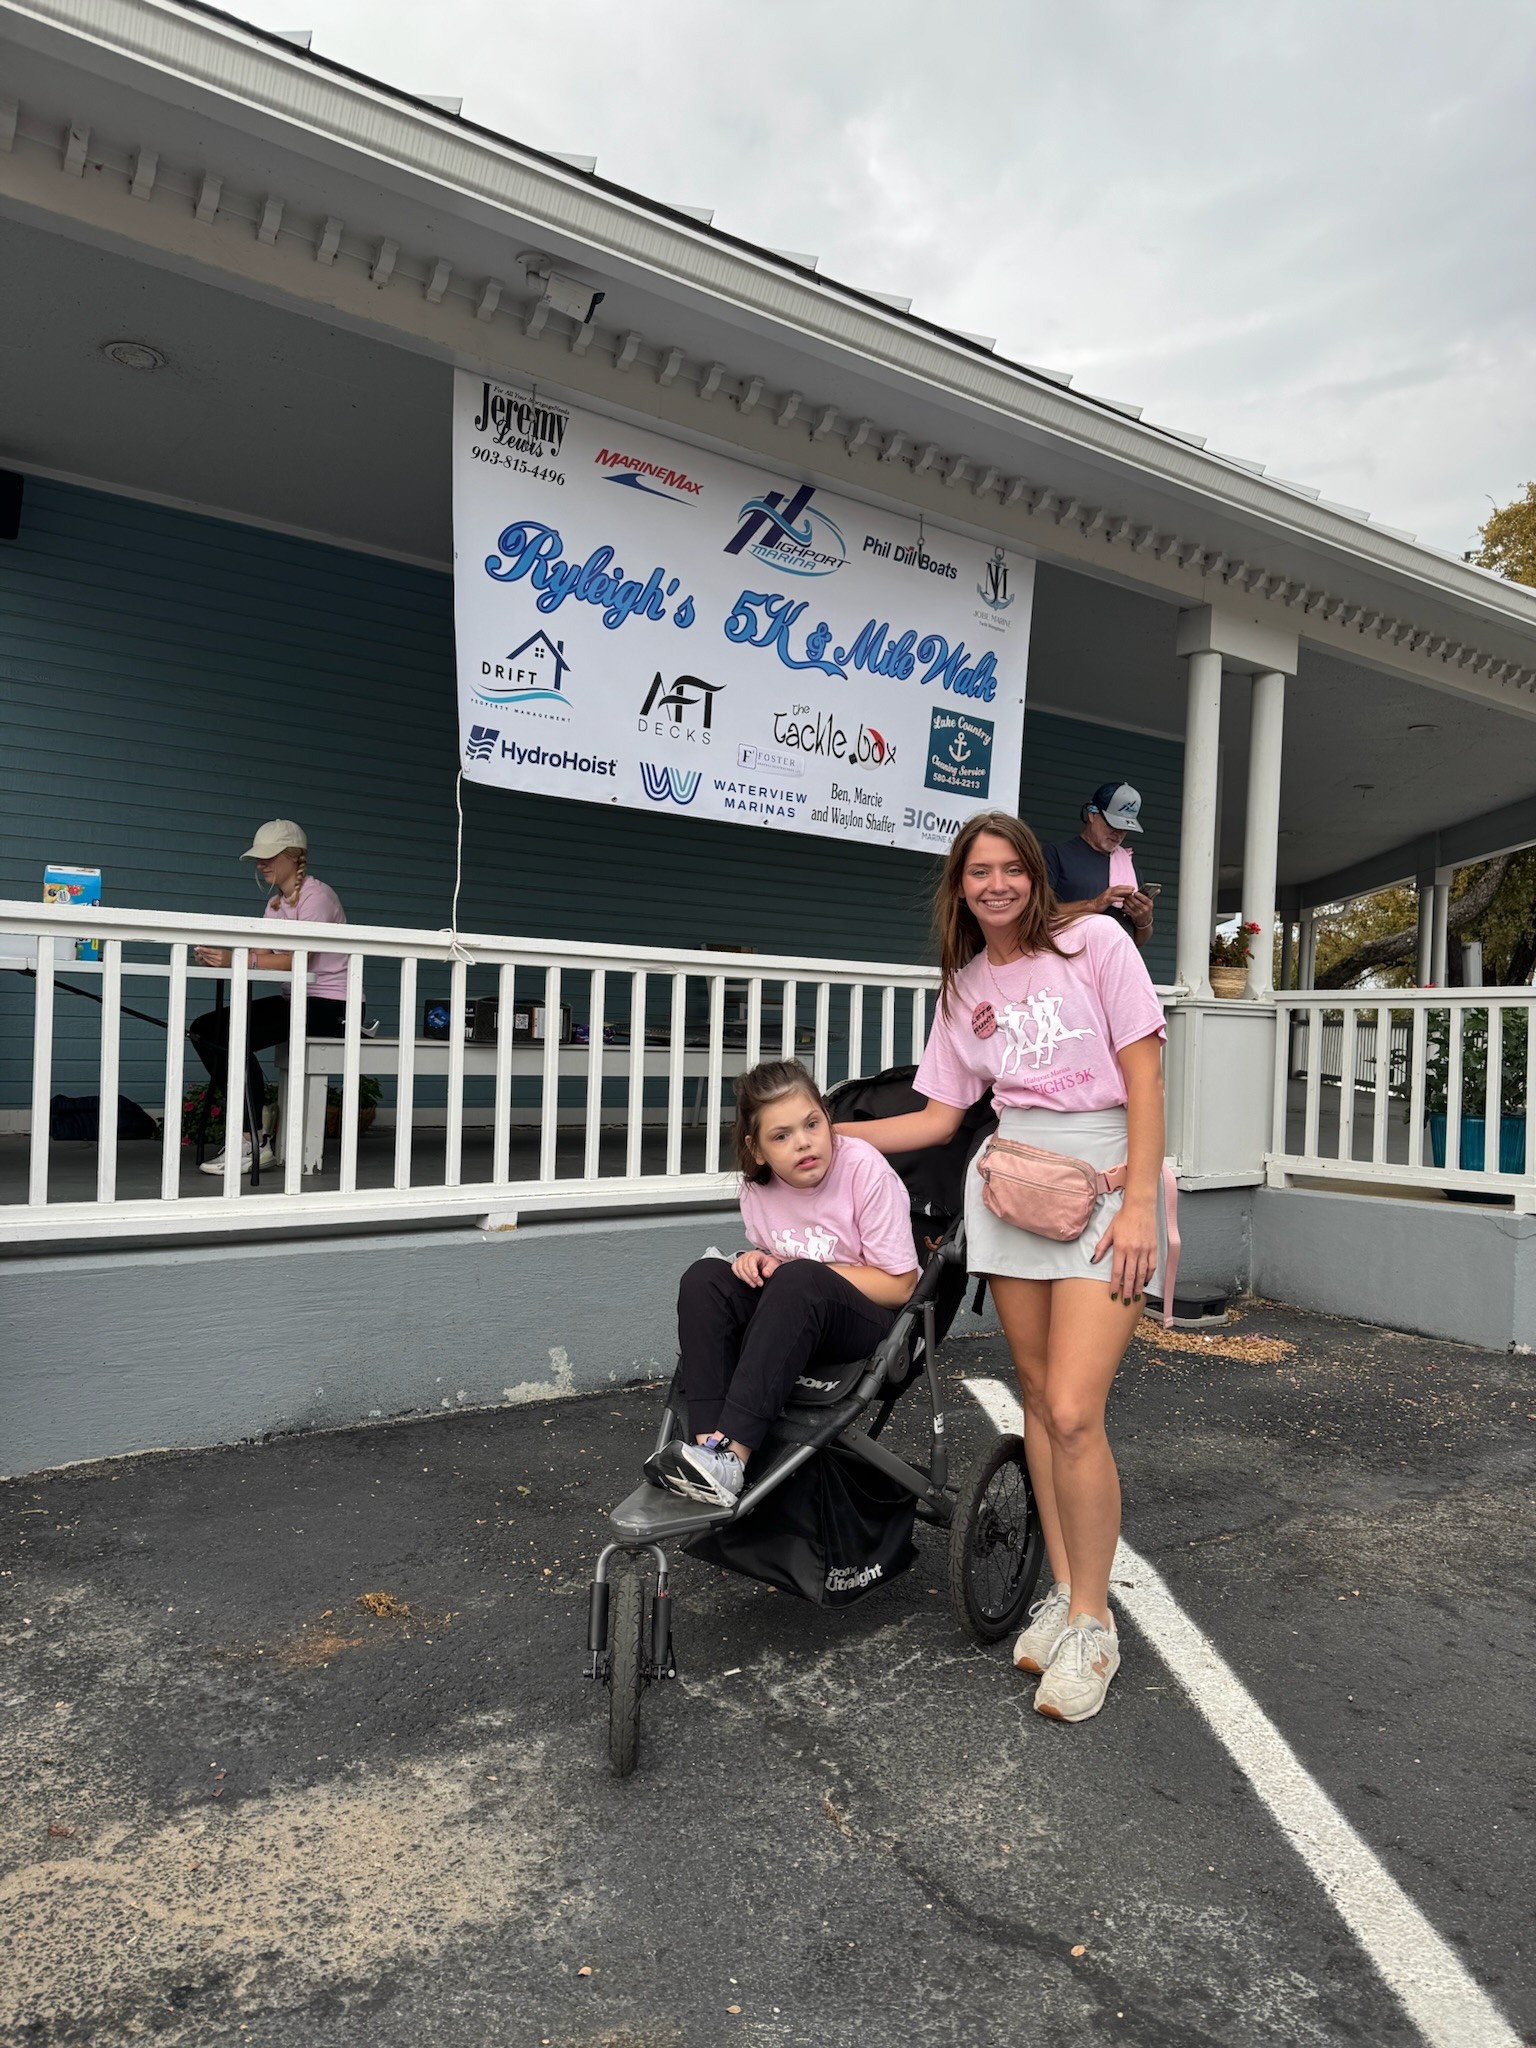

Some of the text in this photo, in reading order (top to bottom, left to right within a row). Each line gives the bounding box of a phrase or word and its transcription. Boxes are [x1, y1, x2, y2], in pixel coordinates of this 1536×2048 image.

[474, 382, 570, 457] Jeremy
[492, 419, 544, 459] Lewis
[470, 446, 565, 486] 903-815-4496
[750, 543, 817, 570] MARINA
[862, 535, 958, 580] Phil Dill Boats
[484, 520, 695, 630] Ryleigh's
[724, 590, 998, 703] 5K & Mile Walk
[482, 661, 538, 685] DRIFT
[639, 671, 727, 729] AFT
[792, 704, 810, 716] the
[638, 718, 711, 745] DECKS
[957, 716, 992, 746] Country
[501, 739, 618, 777] HydroHoist
[758, 752, 796, 767] FOSTER
[714, 779, 807, 804] WATERVIEW
[831, 783, 883, 808] Ben, Marcie
[724, 798, 796, 819] MARINAS
[811, 807, 896, 834] and Waylon Shaffer
[1075, 1067, 1096, 1085] 5K
